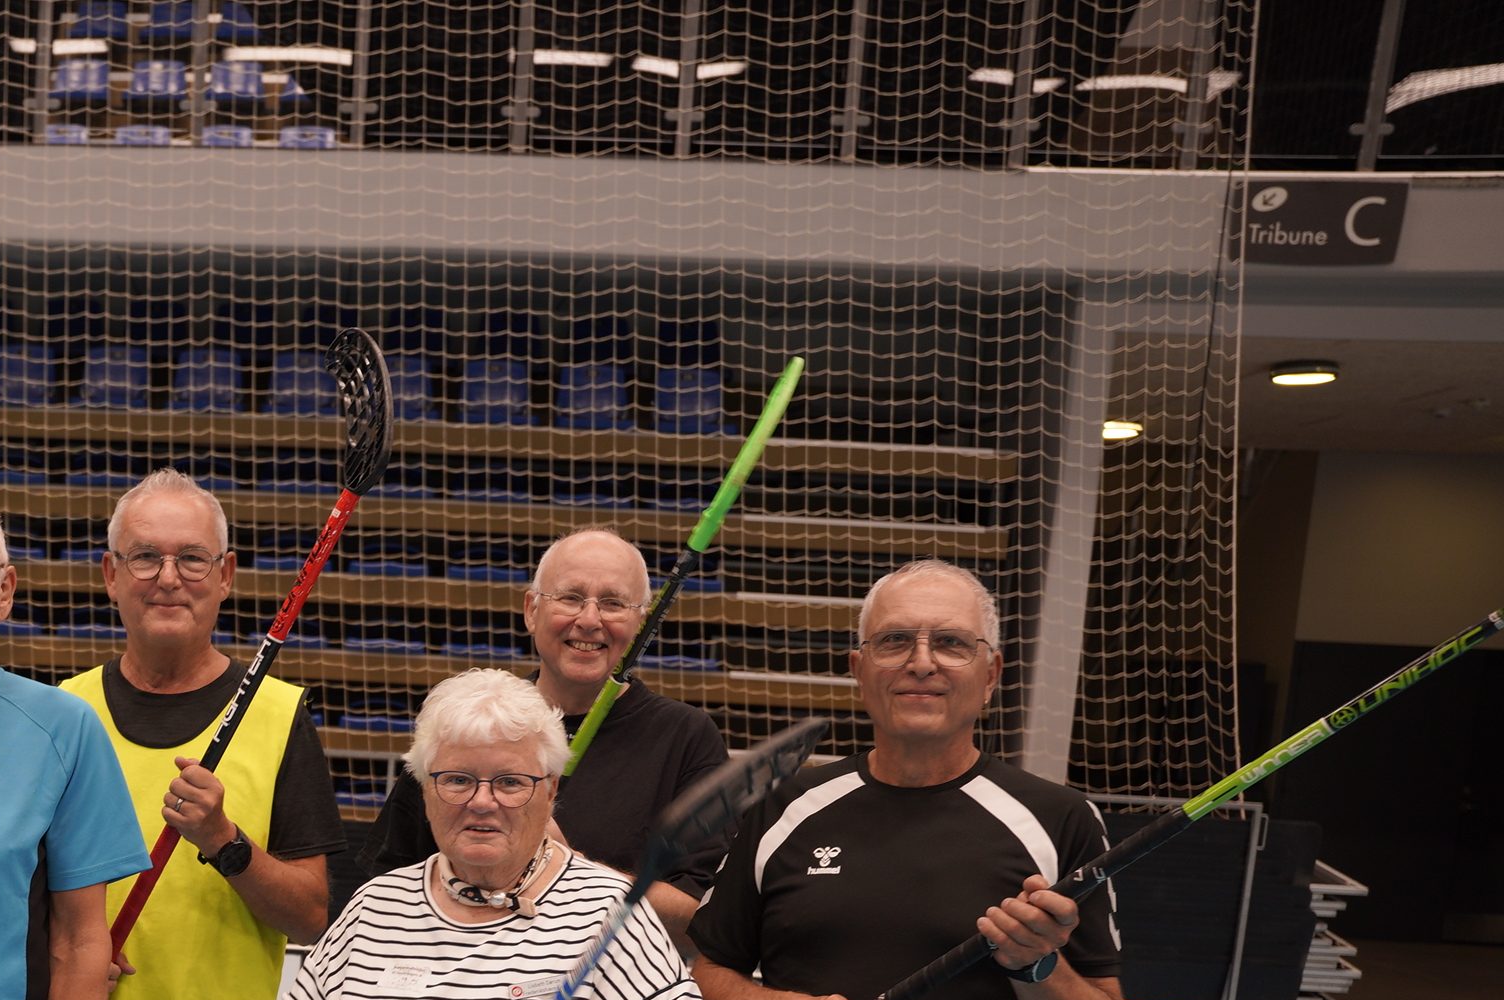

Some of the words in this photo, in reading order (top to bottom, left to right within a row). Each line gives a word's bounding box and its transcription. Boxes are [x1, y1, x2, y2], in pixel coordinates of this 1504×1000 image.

[1249, 221, 1329, 246] Tribune
[1344, 196, 1387, 247] C
[1358, 625, 1485, 713] UNIHOC
